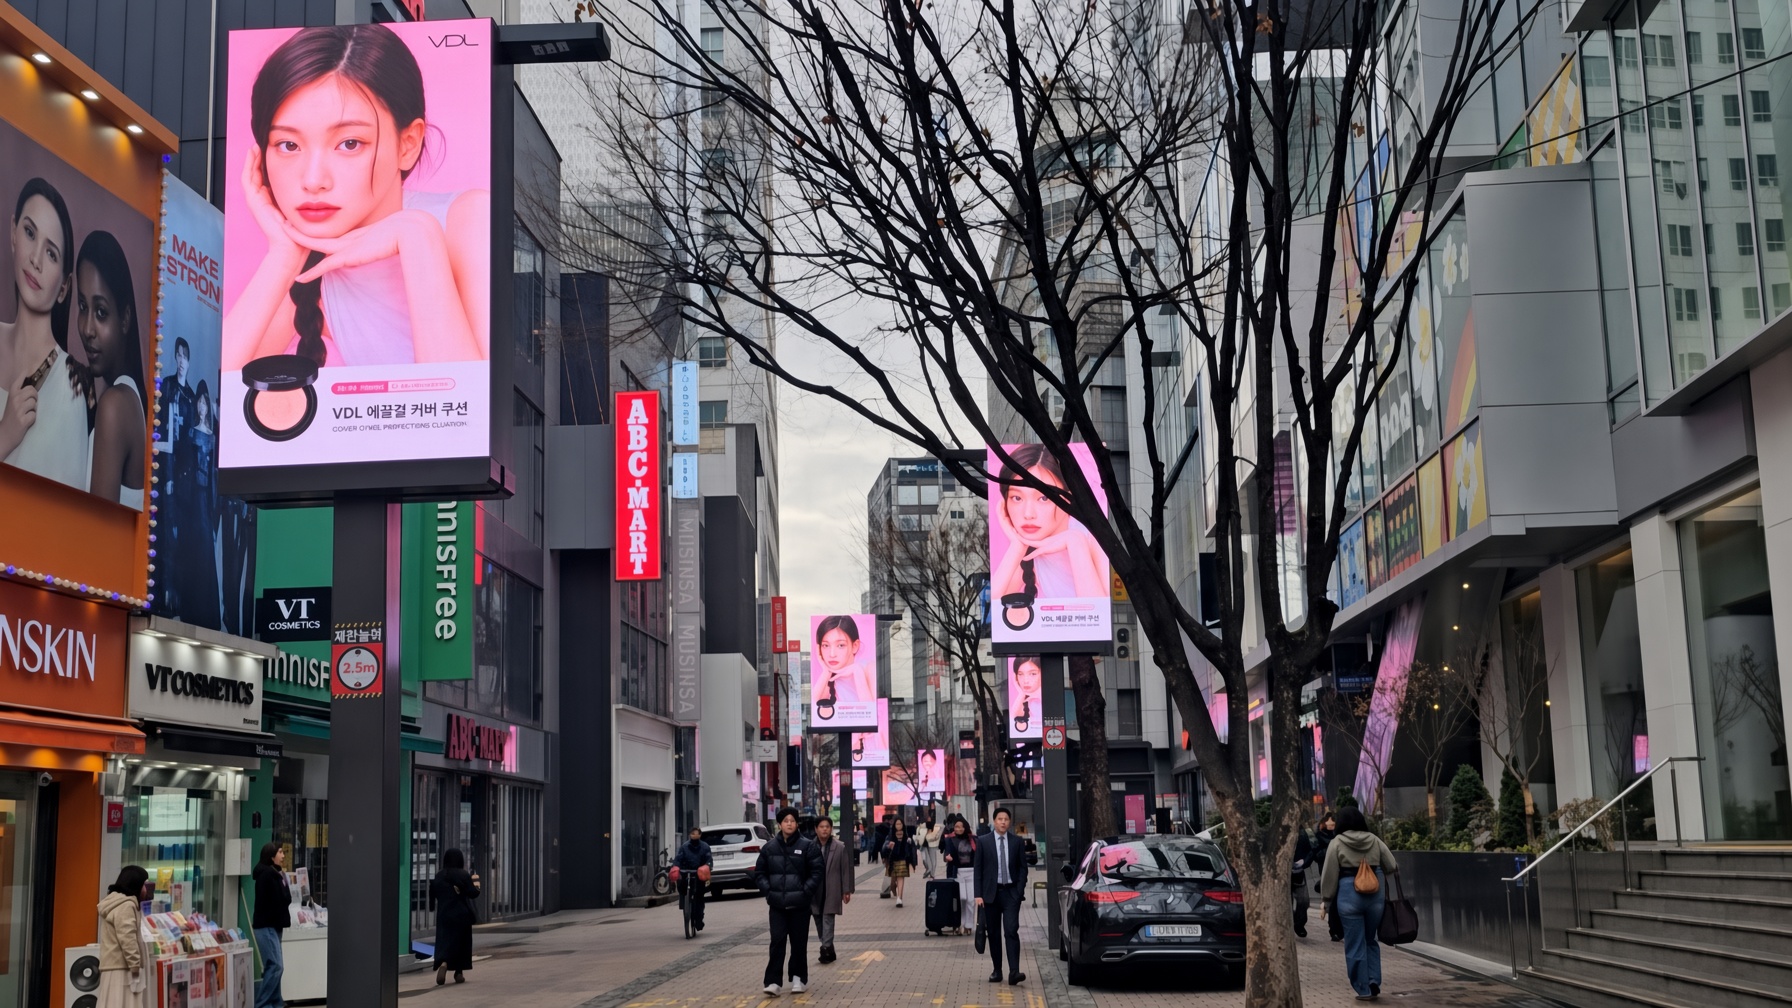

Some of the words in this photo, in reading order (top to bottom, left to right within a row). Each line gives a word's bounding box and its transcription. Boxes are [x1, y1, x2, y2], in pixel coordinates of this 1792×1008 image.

[428, 34, 479, 48] VDL
[172, 233, 219, 281] MAKE
[166, 254, 220, 305] STRON
[332, 406, 363, 419] VDL
[411, 402, 437, 418] 커버
[441, 401, 468, 416] 쿠션
[678, 518, 694, 605] MUSINSA
[275, 598, 316, 620] VT
[268, 620, 321, 631] COSMETICS
[145, 662, 173, 692] VT
[171, 669, 254, 705] COSMETICS
[342, 662, 375, 674] 2.5m
[678, 625, 695, 714] MUSINSA
